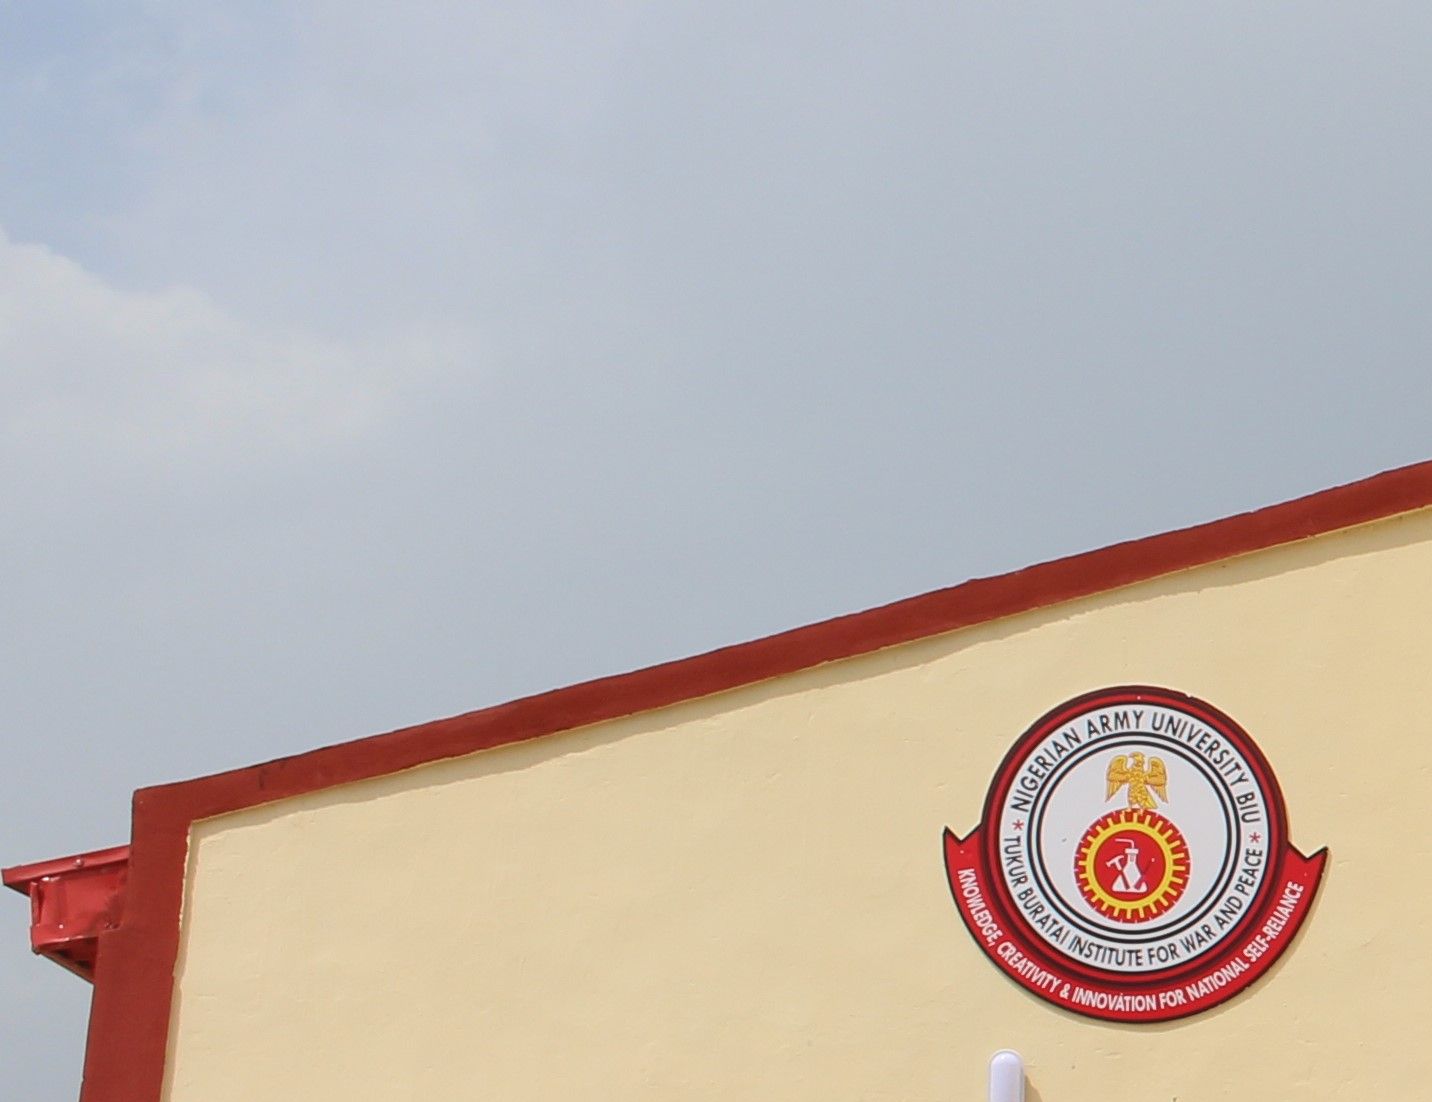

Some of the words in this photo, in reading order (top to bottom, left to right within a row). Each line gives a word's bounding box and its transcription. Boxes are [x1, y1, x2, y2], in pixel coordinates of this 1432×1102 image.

[1012, 728, 1082, 813] NIGERIAN
[1087, 710, 1144, 739] ARMY
[1152, 713, 1249, 787] UNIVERSITY
[1236, 792, 1261, 823] BIU
[958, 868, 1000, 948] KNOWLEDGE,
[997, 941, 1062, 994] CREATIVITY
[1059, 985, 1070, 1000] &
[1072, 990, 1157, 1011] INNOVATION
[1160, 988, 1185, 1009] FOR
[1186, 957, 1250, 1003] NATIONAL
[1243, 880, 1305, 963] SELF-RELIANCE
[1004, 836, 1027, 887] TUKUR
[1018, 887, 1068, 944] BURATAI
[1070, 938, 1143, 967] INSTITUTE
[1148, 945, 1180, 965] FOR
[1180, 924, 1217, 953] WAR
[1218, 899, 1244, 930] AND
[1238, 848, 1263, 898] PEACE
